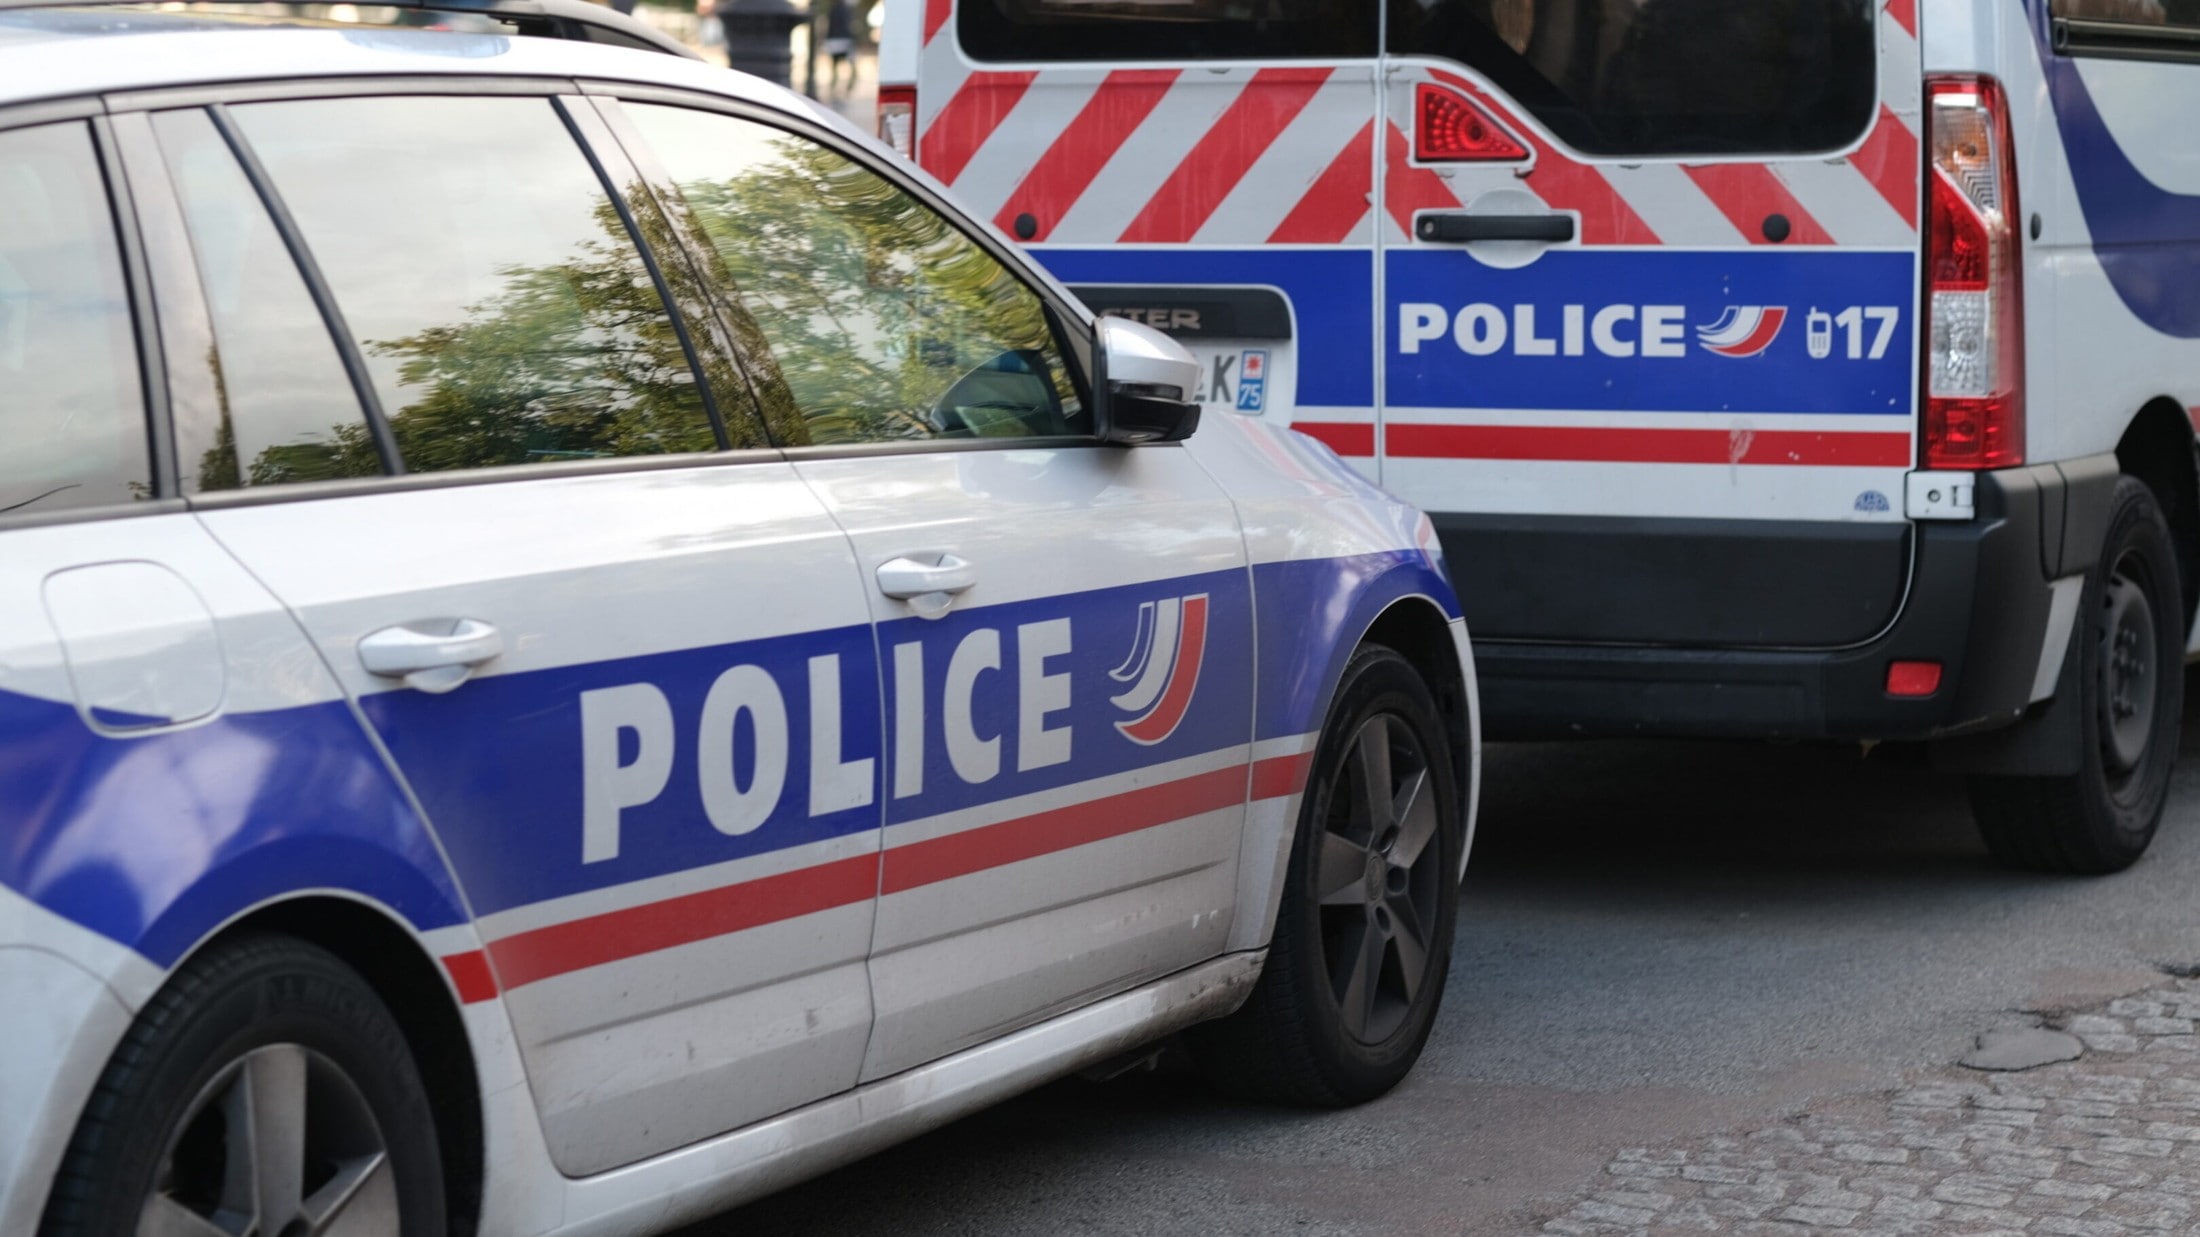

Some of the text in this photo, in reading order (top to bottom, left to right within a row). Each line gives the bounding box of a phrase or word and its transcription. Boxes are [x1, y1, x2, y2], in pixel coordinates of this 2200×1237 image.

[1399, 303, 1899, 359] POLICE 17
[1240, 384, 1261, 407] 75
[580, 617, 1072, 864] POLICE
